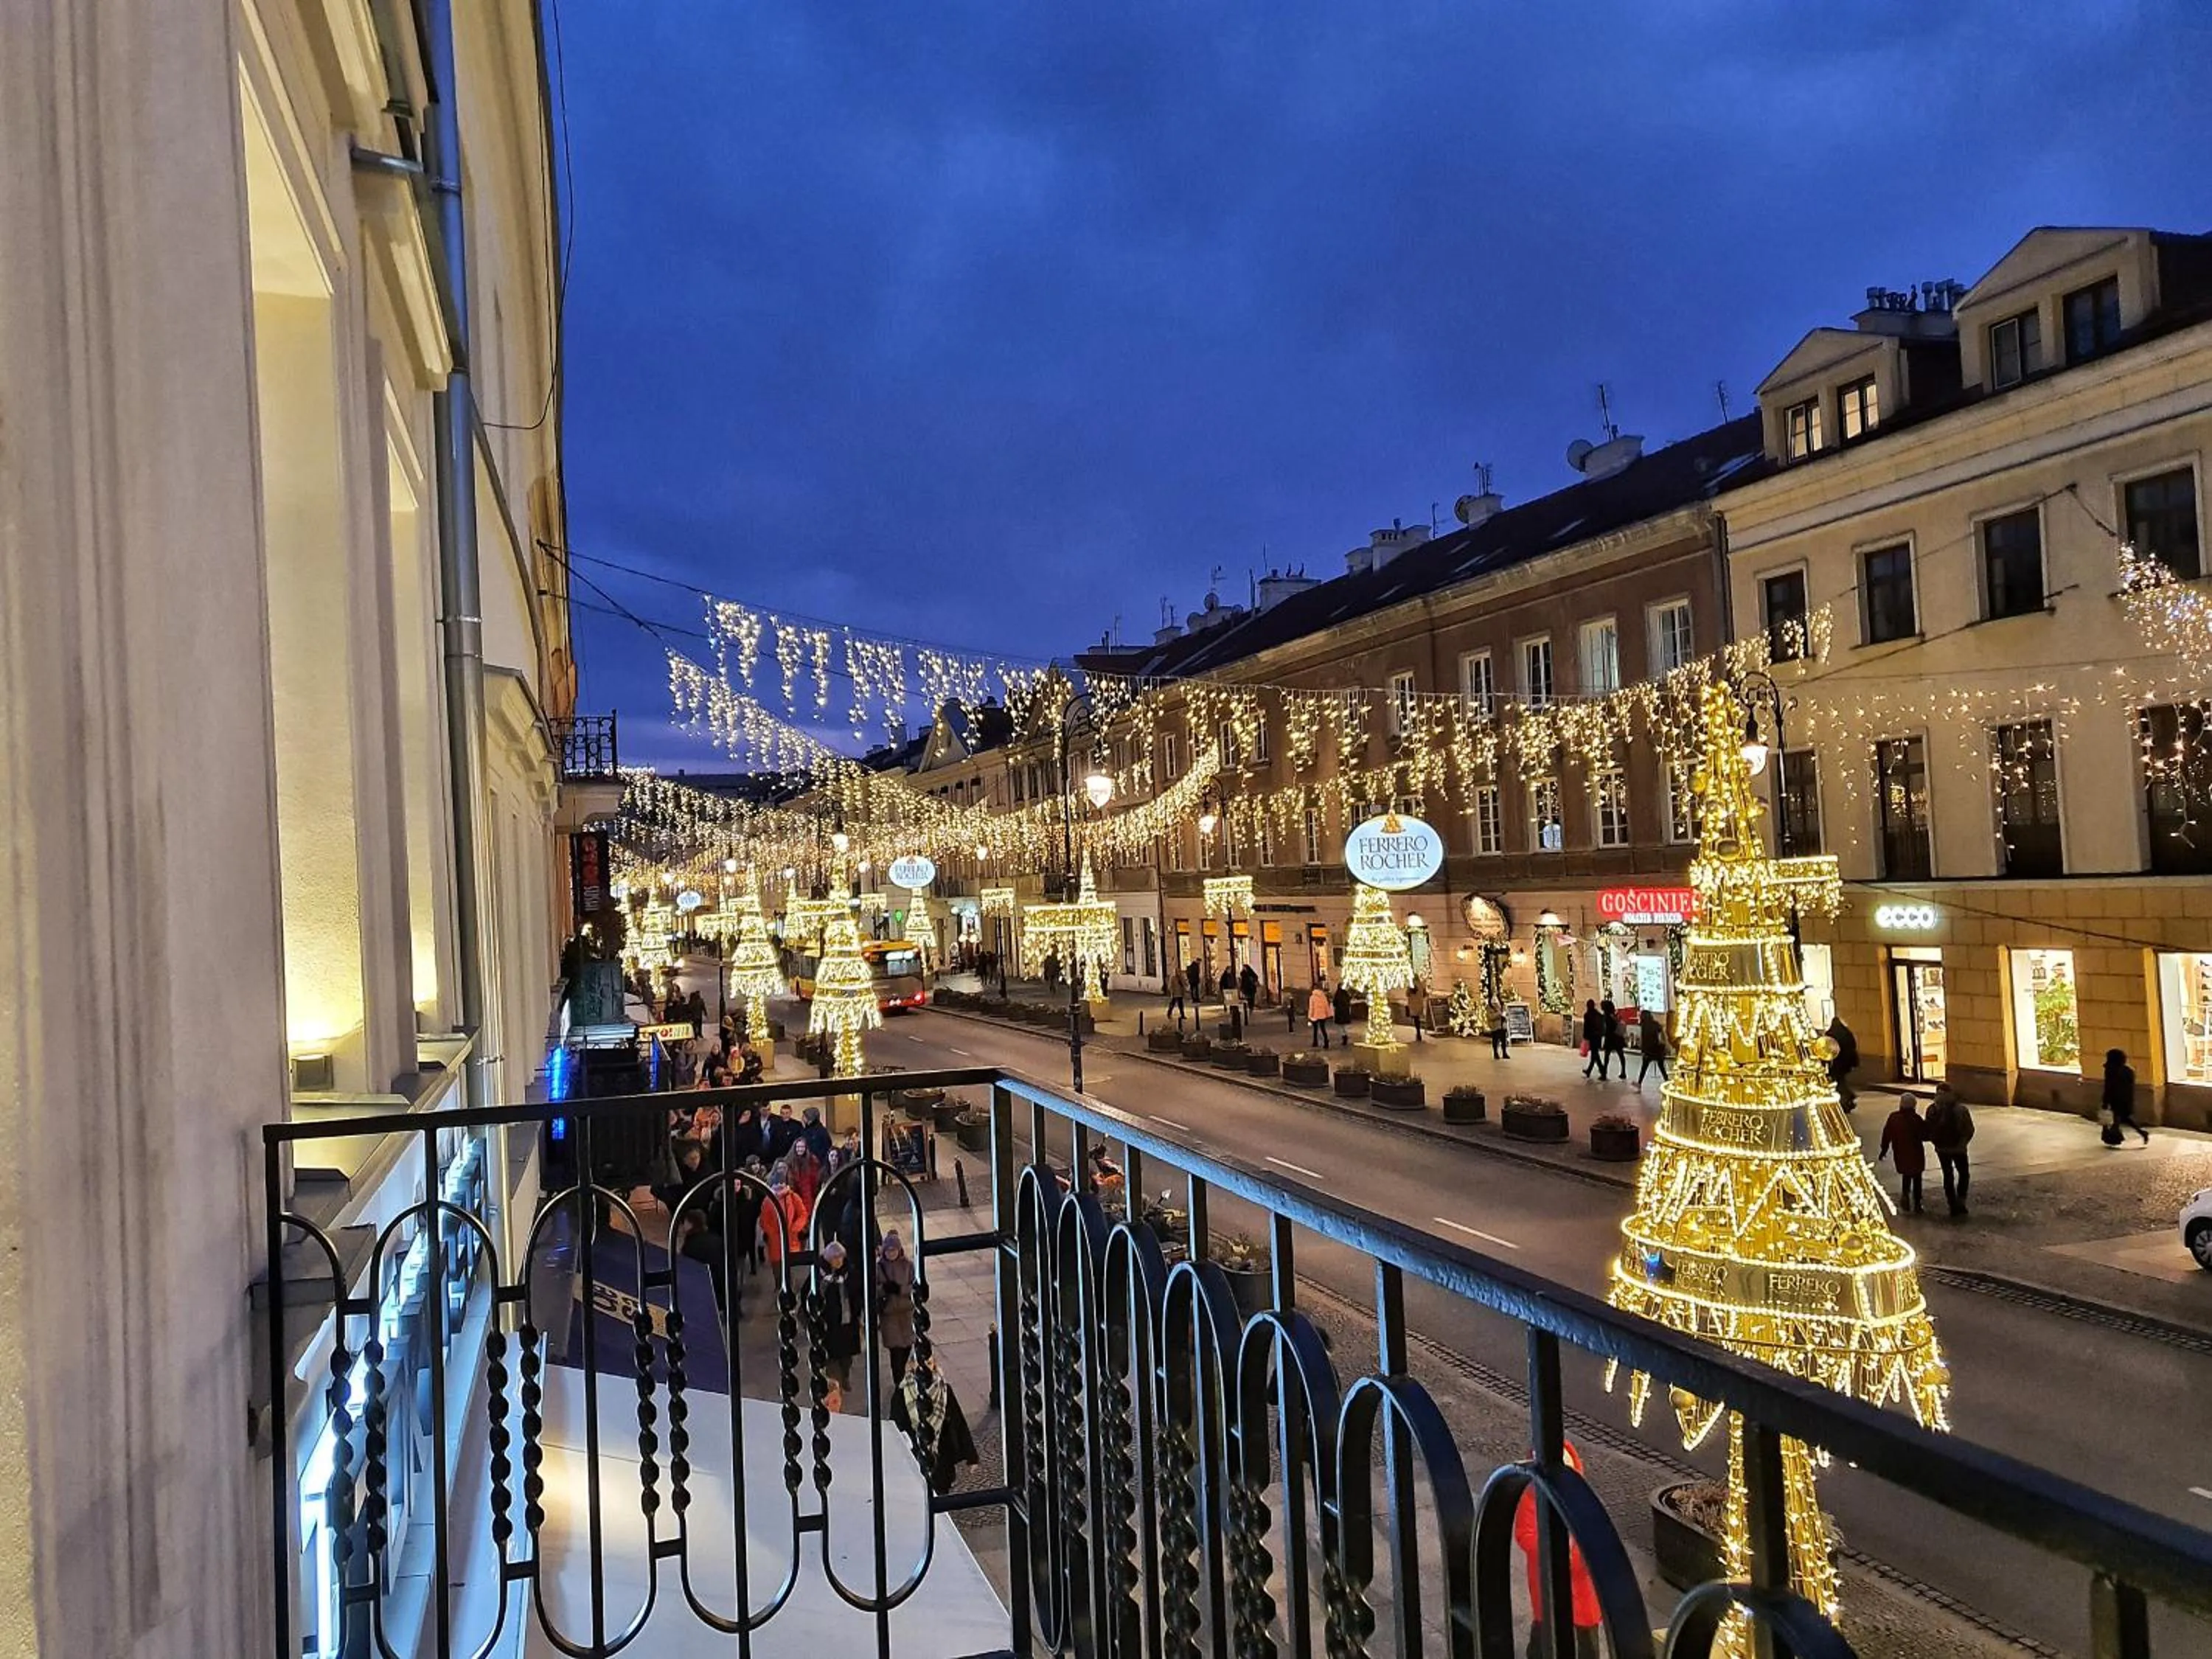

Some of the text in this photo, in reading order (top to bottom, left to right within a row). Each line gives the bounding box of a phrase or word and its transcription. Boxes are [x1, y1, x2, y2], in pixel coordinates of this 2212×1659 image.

[1359, 835, 1428, 853] FERRERO
[1360, 852, 1429, 870] ROCHER
[1769, 1273, 1841, 1295] FERRERO
